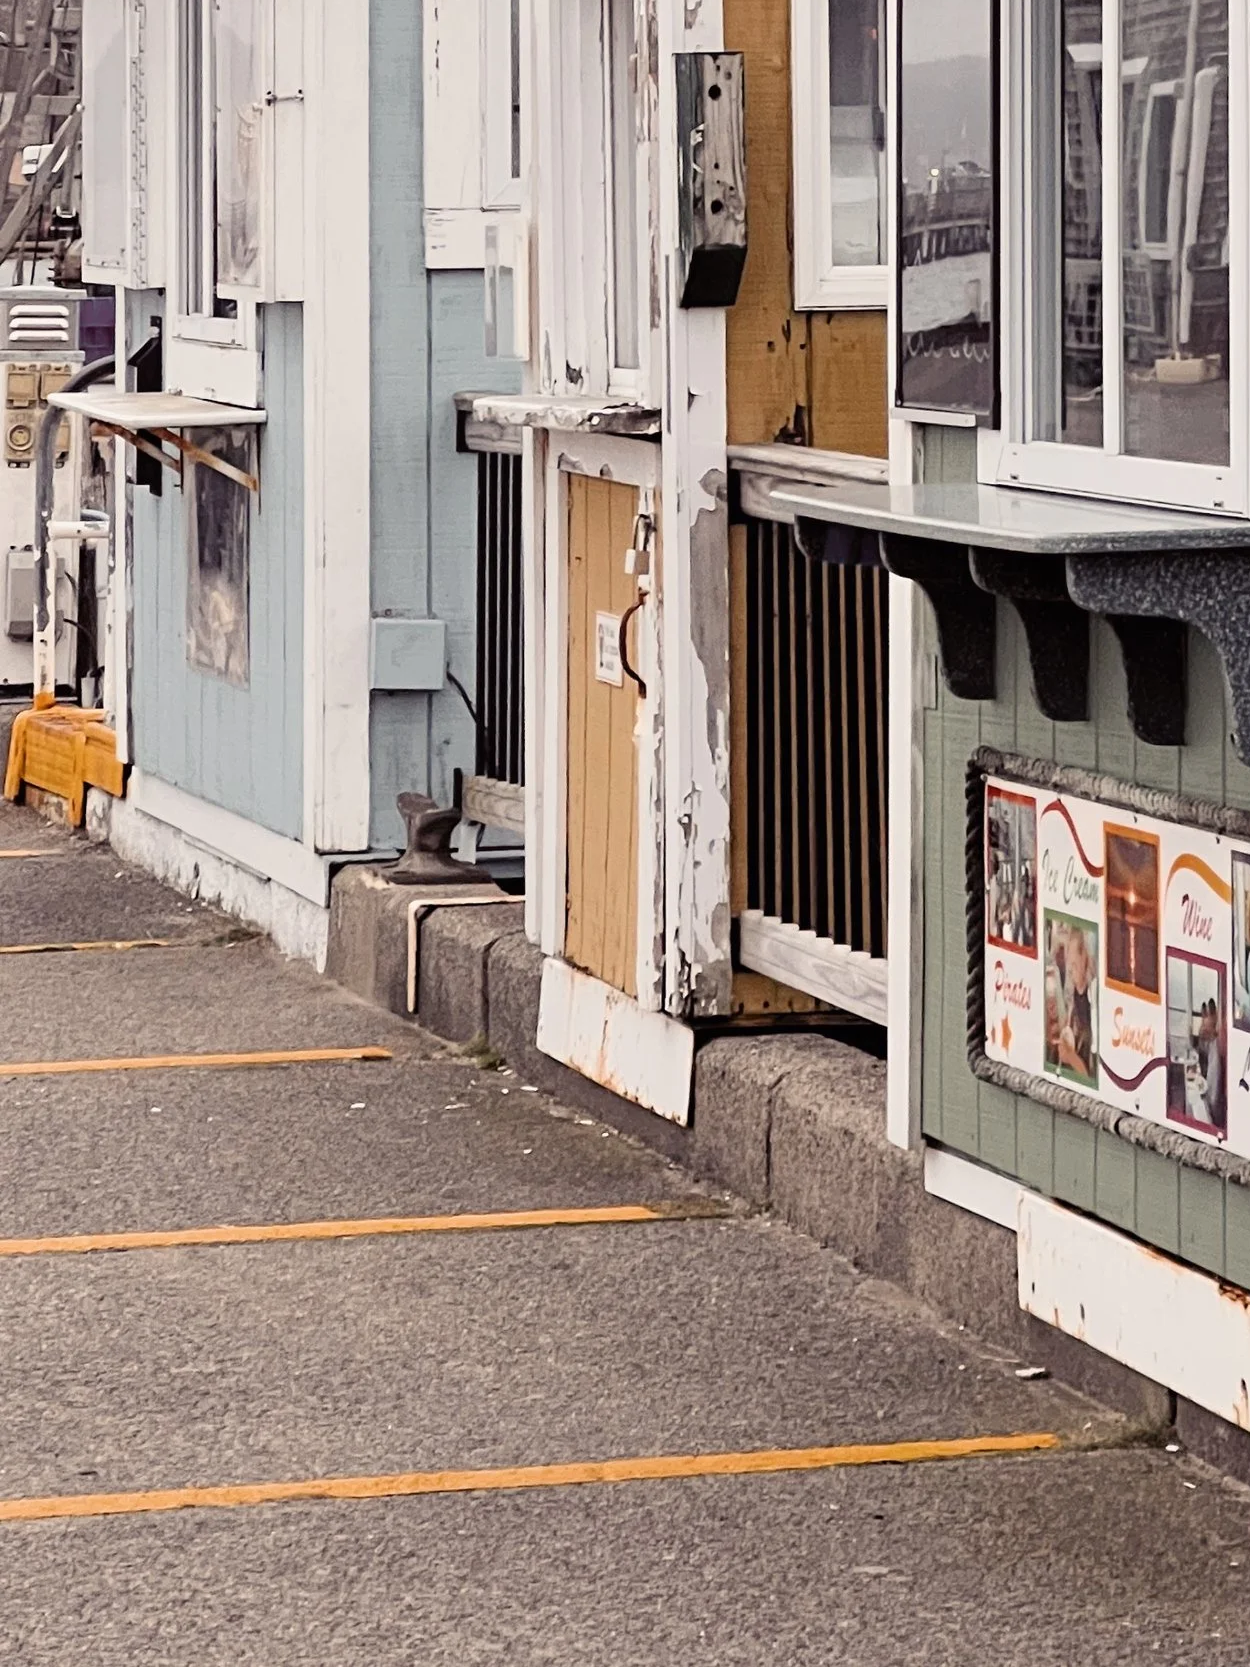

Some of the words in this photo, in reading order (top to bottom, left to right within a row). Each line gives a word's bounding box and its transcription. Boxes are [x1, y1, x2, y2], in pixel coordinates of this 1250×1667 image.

[1041, 848, 1059, 893] Ice
[1063, 855, 1100, 905] Cream
[1181, 893, 1214, 942] Wine
[994, 960, 1031, 1009] Pirates
[1112, 1006, 1155, 1057] Sunsets
